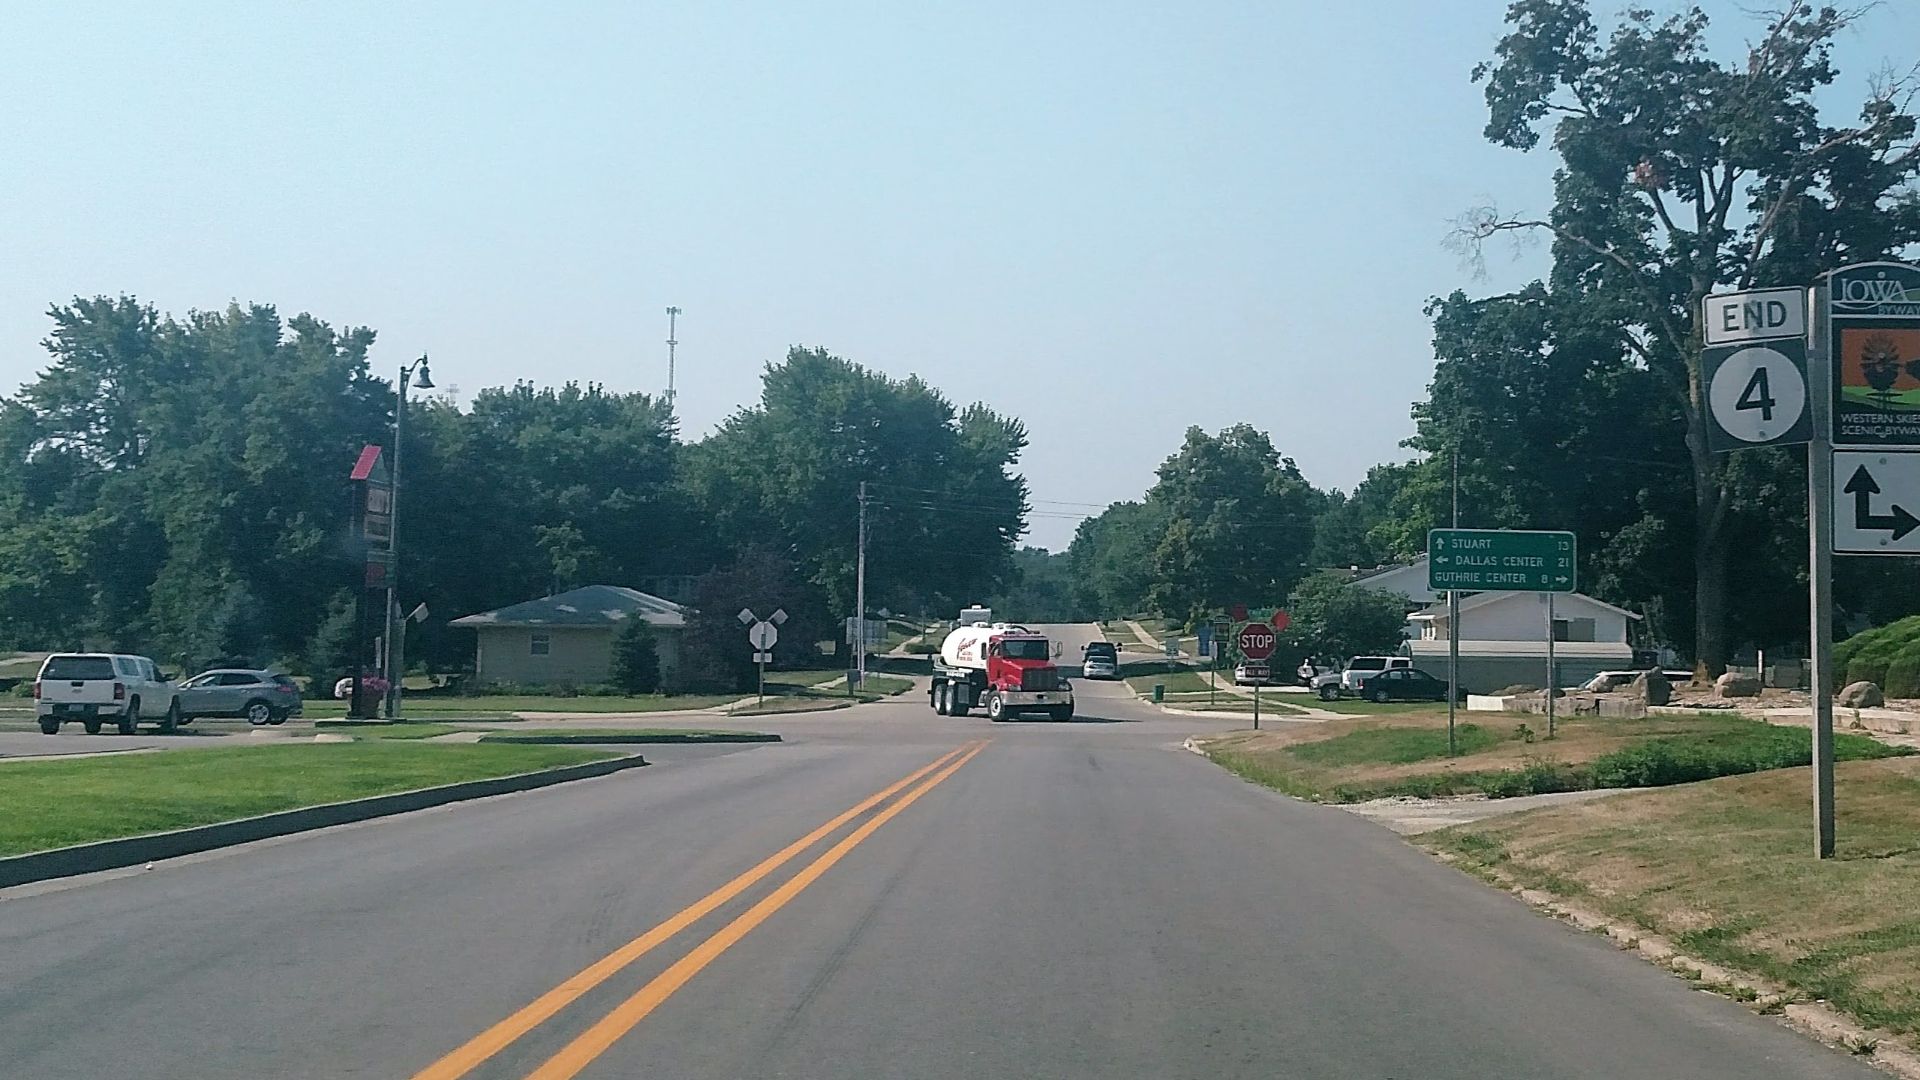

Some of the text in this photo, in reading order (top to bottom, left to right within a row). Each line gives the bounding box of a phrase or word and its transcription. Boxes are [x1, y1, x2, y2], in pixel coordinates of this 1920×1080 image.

[1841, 278, 1909, 302] IOWA
[1722, 300, 1788, 332] END
[1735, 366, 1776, 421] 4
[1840, 413, 1893, 424] WESTERN
[1841, 425, 1881, 435] SCENIC
[1451, 538, 1570, 551] STUART 13
[1455, 555, 1569, 568] DALLAS CENTER 21
[1434, 571, 1548, 584] GUTHRIE CENTER 8
[1241, 634, 1273, 648] STOP
